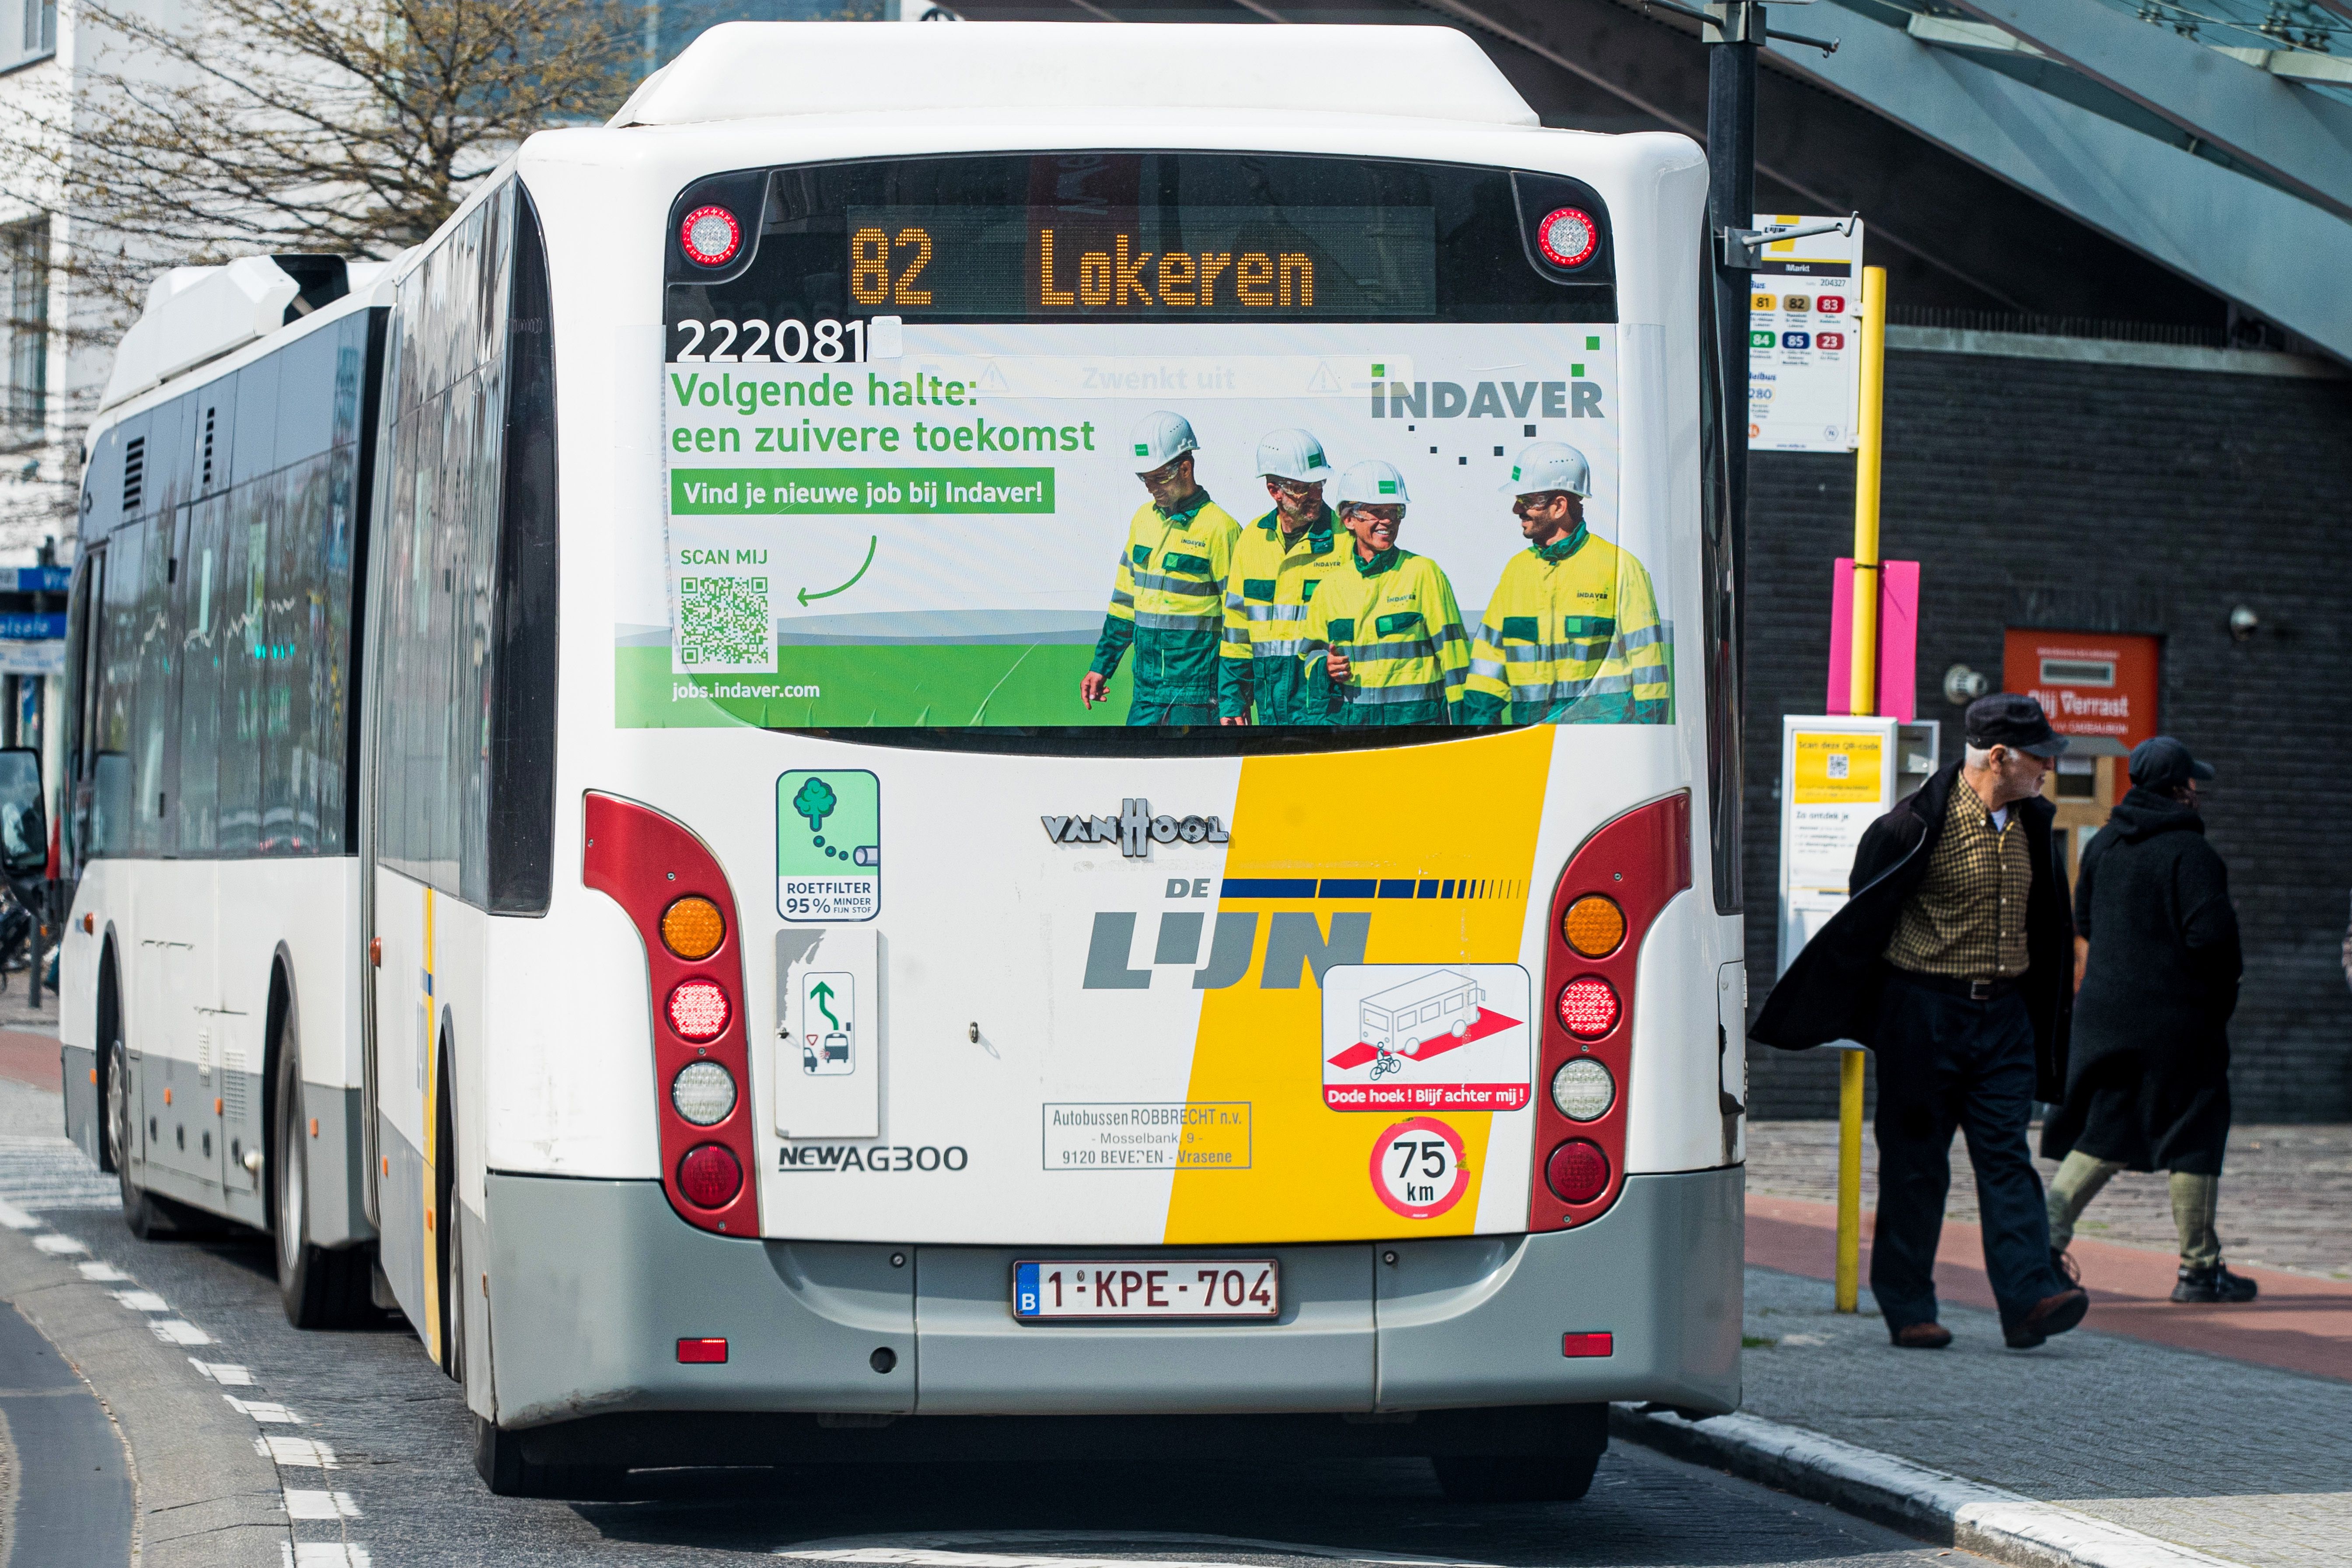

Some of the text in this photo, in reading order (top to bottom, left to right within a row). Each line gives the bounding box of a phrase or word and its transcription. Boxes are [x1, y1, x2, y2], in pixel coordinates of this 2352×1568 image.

[852, 227, 1313, 306] 82 Lokeren
[1756, 297, 1838, 311] 81 82 83
[677, 319, 864, 362] 222081
[1753, 334, 1838, 348] 84 85 23
[671, 372, 977, 415] Volgende halte:
[1372, 364, 1605, 419] INDAVER
[672, 418, 1095, 452] een zuivere toekomst
[684, 482, 1043, 509] Vind je nieuwe job bij Indaver!
[681, 549, 768, 565] SCAN MIJ
[672, 682, 820, 701] jobs.indaver.com
[788, 883, 871, 894] ROETFILTER
[1165, 879, 1210, 898] DE
[1082, 912, 1372, 989] LIJN
[1328, 1090, 1367, 1103] Dode
[1416, 1089, 1443, 1107] Blijf
[1445, 1088, 1493, 1103] achter
[1053, 1109, 1242, 1125] Autobussen ROBBRECHT n.v.
[1101, 1133, 1182, 1145] Mosselbank,
[1186, 1133, 1195, 1144] 9
[1063, 1151, 1096, 1164] 9120
[1178, 1150, 1232, 1164] Vrasene
[1394, 1141, 1446, 1178] 75
[1407, 1182, 1434, 1201] km
[1048, 1269, 1271, 1307] 1-KPE-704
[1022, 1293, 1036, 1310] B
